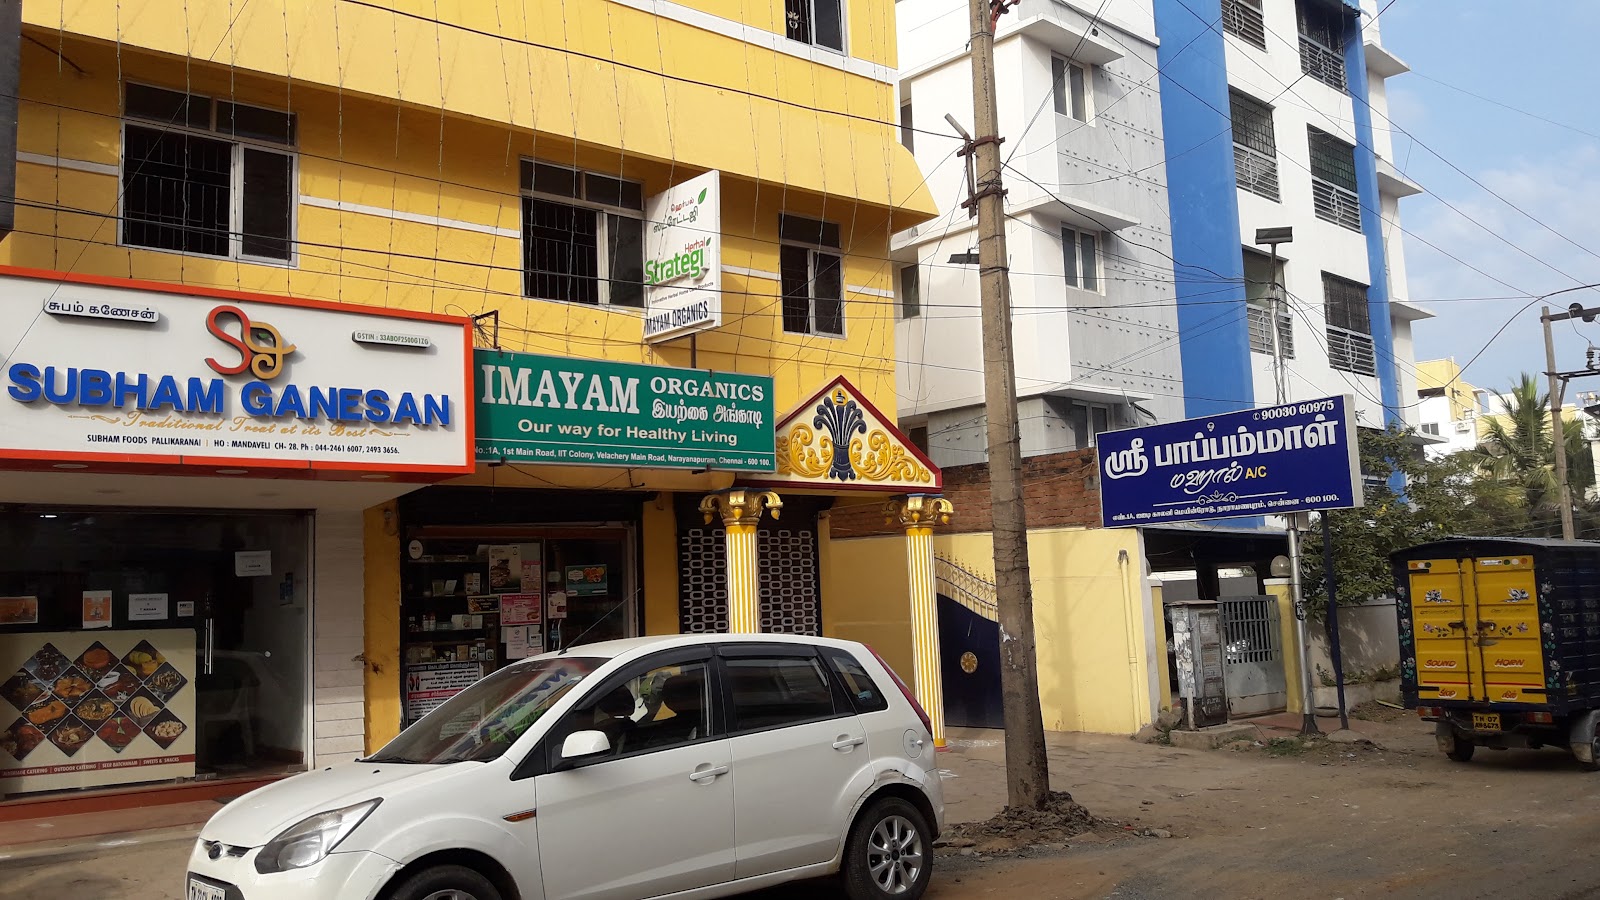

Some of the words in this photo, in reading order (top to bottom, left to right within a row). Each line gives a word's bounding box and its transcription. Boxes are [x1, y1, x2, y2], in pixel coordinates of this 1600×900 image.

[644, 249, 704, 285] Strategi
[48, 301, 84, 313] சுபம்
[89, 304, 156, 320] கணேசன்
[672, 300, 709, 327] ORGANICS
[356, 332, 375, 340] GSTIN
[7, 362, 225, 413] SUBHAM
[241, 380, 450, 427] GANESAN
[481, 364, 640, 415] IMAYAM
[649, 375, 765, 402] ORGANICS
[123, 410, 226, 431] Traditional
[230, 416, 277, 434] Treat
[280, 423, 298, 435] at
[301, 424, 322, 436] its
[329, 422, 370, 437] Best
[651, 398, 709, 424] இயற்கை
[712, 402, 763, 430] அங்காடி
[1261, 405, 1297, 421] 90030
[1299, 400, 1335, 416] 60975
[87, 434, 120, 443] SUBHAM
[122, 435, 148, 445] FOODS
[151, 436, 201, 447] PALLIKARANAI
[231, 440, 271, 449] MANDAVELI
[300, 443, 309, 451] Ph
[315, 444, 345, 453] 044-2461
[346, 446, 365, 454] 6007,
[366, 446, 381, 454] 2493
[517, 418, 553, 434] Our
[557, 424, 593, 439] way
[597, 423, 621, 436] for
[626, 425, 688, 444] Healthy
[691, 429, 739, 446] Living
[1154, 413, 1339, 467] பாப்பம்மாள்
[502, 446, 515, 455] 1st
[515, 447, 534, 457] Main
[535, 448, 557, 458] Road,
[558, 449, 567, 458] IIT
[569, 449, 595, 460] Colony,
[596, 451, 630, 462] Velachery
[630, 452, 647, 461] Main
[648, 453, 667, 463] Road,
[667, 454, 718, 464] Narayanapuram,
[719, 455, 744, 465] Chennai
[748, 458, 759, 466] 600
[1170, 460, 1244, 494] மஹால்
[1245, 465, 1268, 480] A/C
[1267, 498, 1300, 508] சென்னை
[1305, 495, 1322, 504] 600
[1424, 659, 1458, 669] SOUND
[1494, 658, 1526, 669] HORN
[53, 765, 76, 773] OUTDOOR
[76, 763, 97, 771] CATERING
